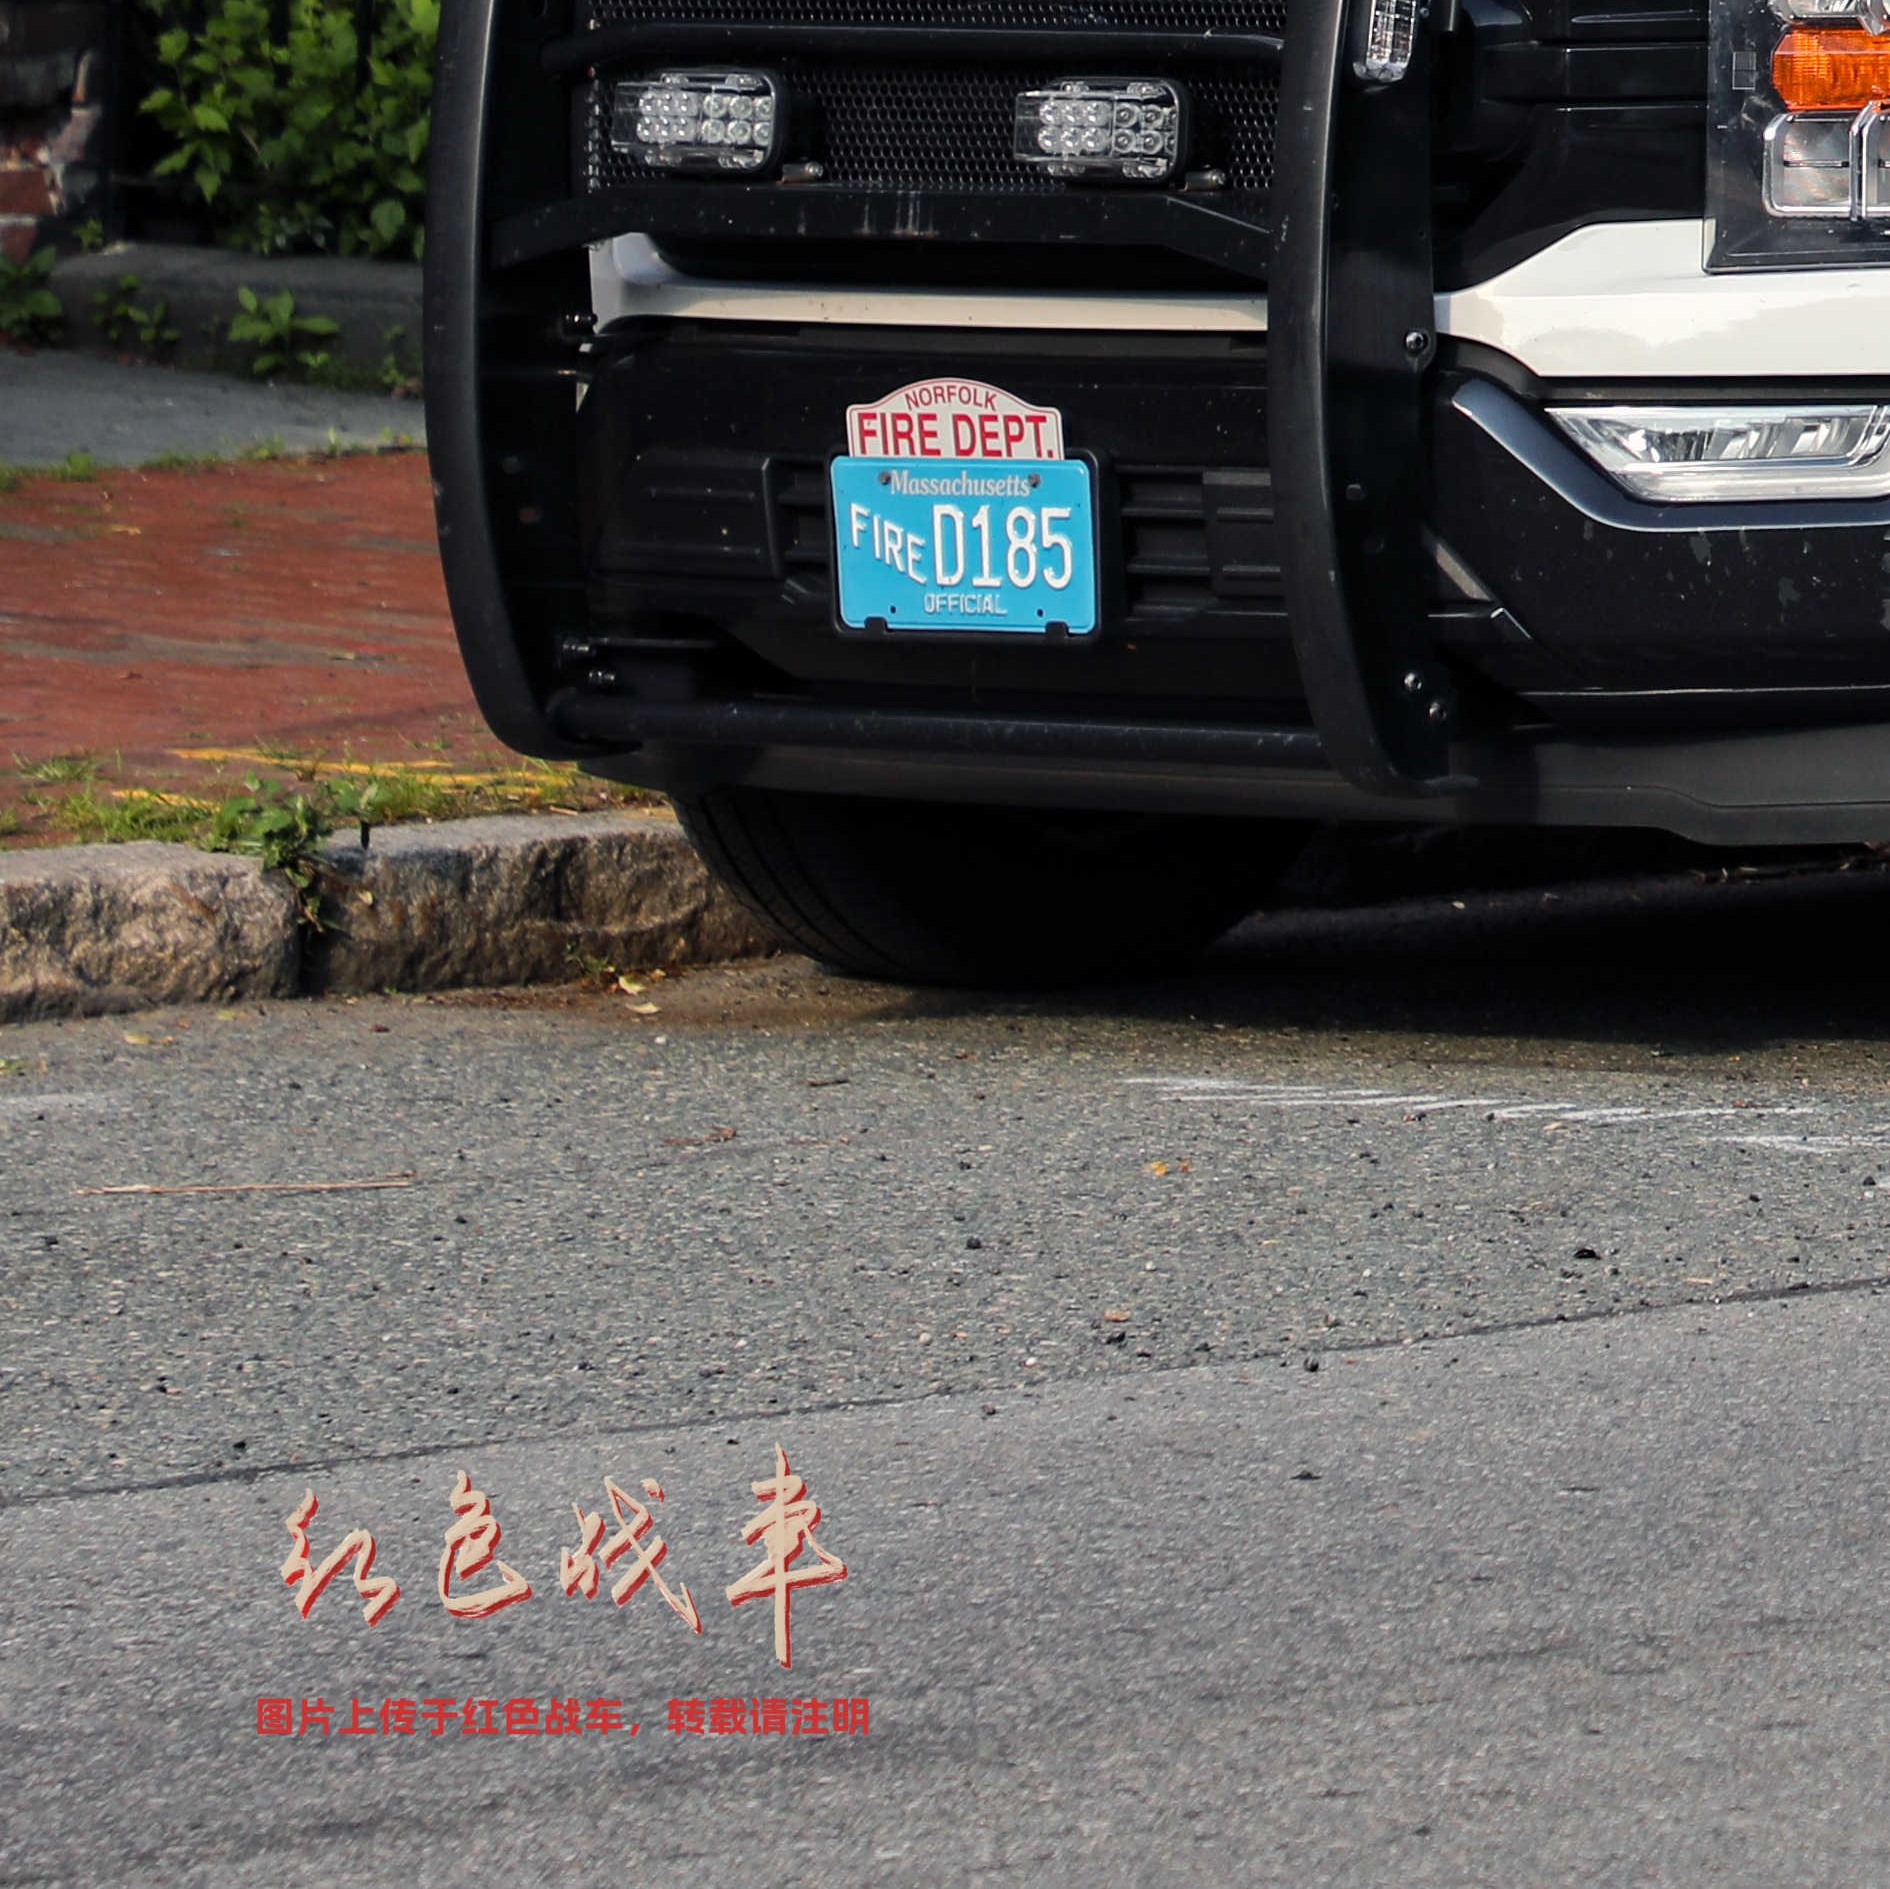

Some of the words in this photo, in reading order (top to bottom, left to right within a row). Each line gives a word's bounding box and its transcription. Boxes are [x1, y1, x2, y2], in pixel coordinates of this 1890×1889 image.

[904, 385, 998, 412] NORFOLK
[857, 412, 942, 456] FIRE
[952, 414, 1055, 459] DEPT.
[889, 469, 1031, 497] Massachusetts
[923, 593, 1008, 615] OFFICIAL
